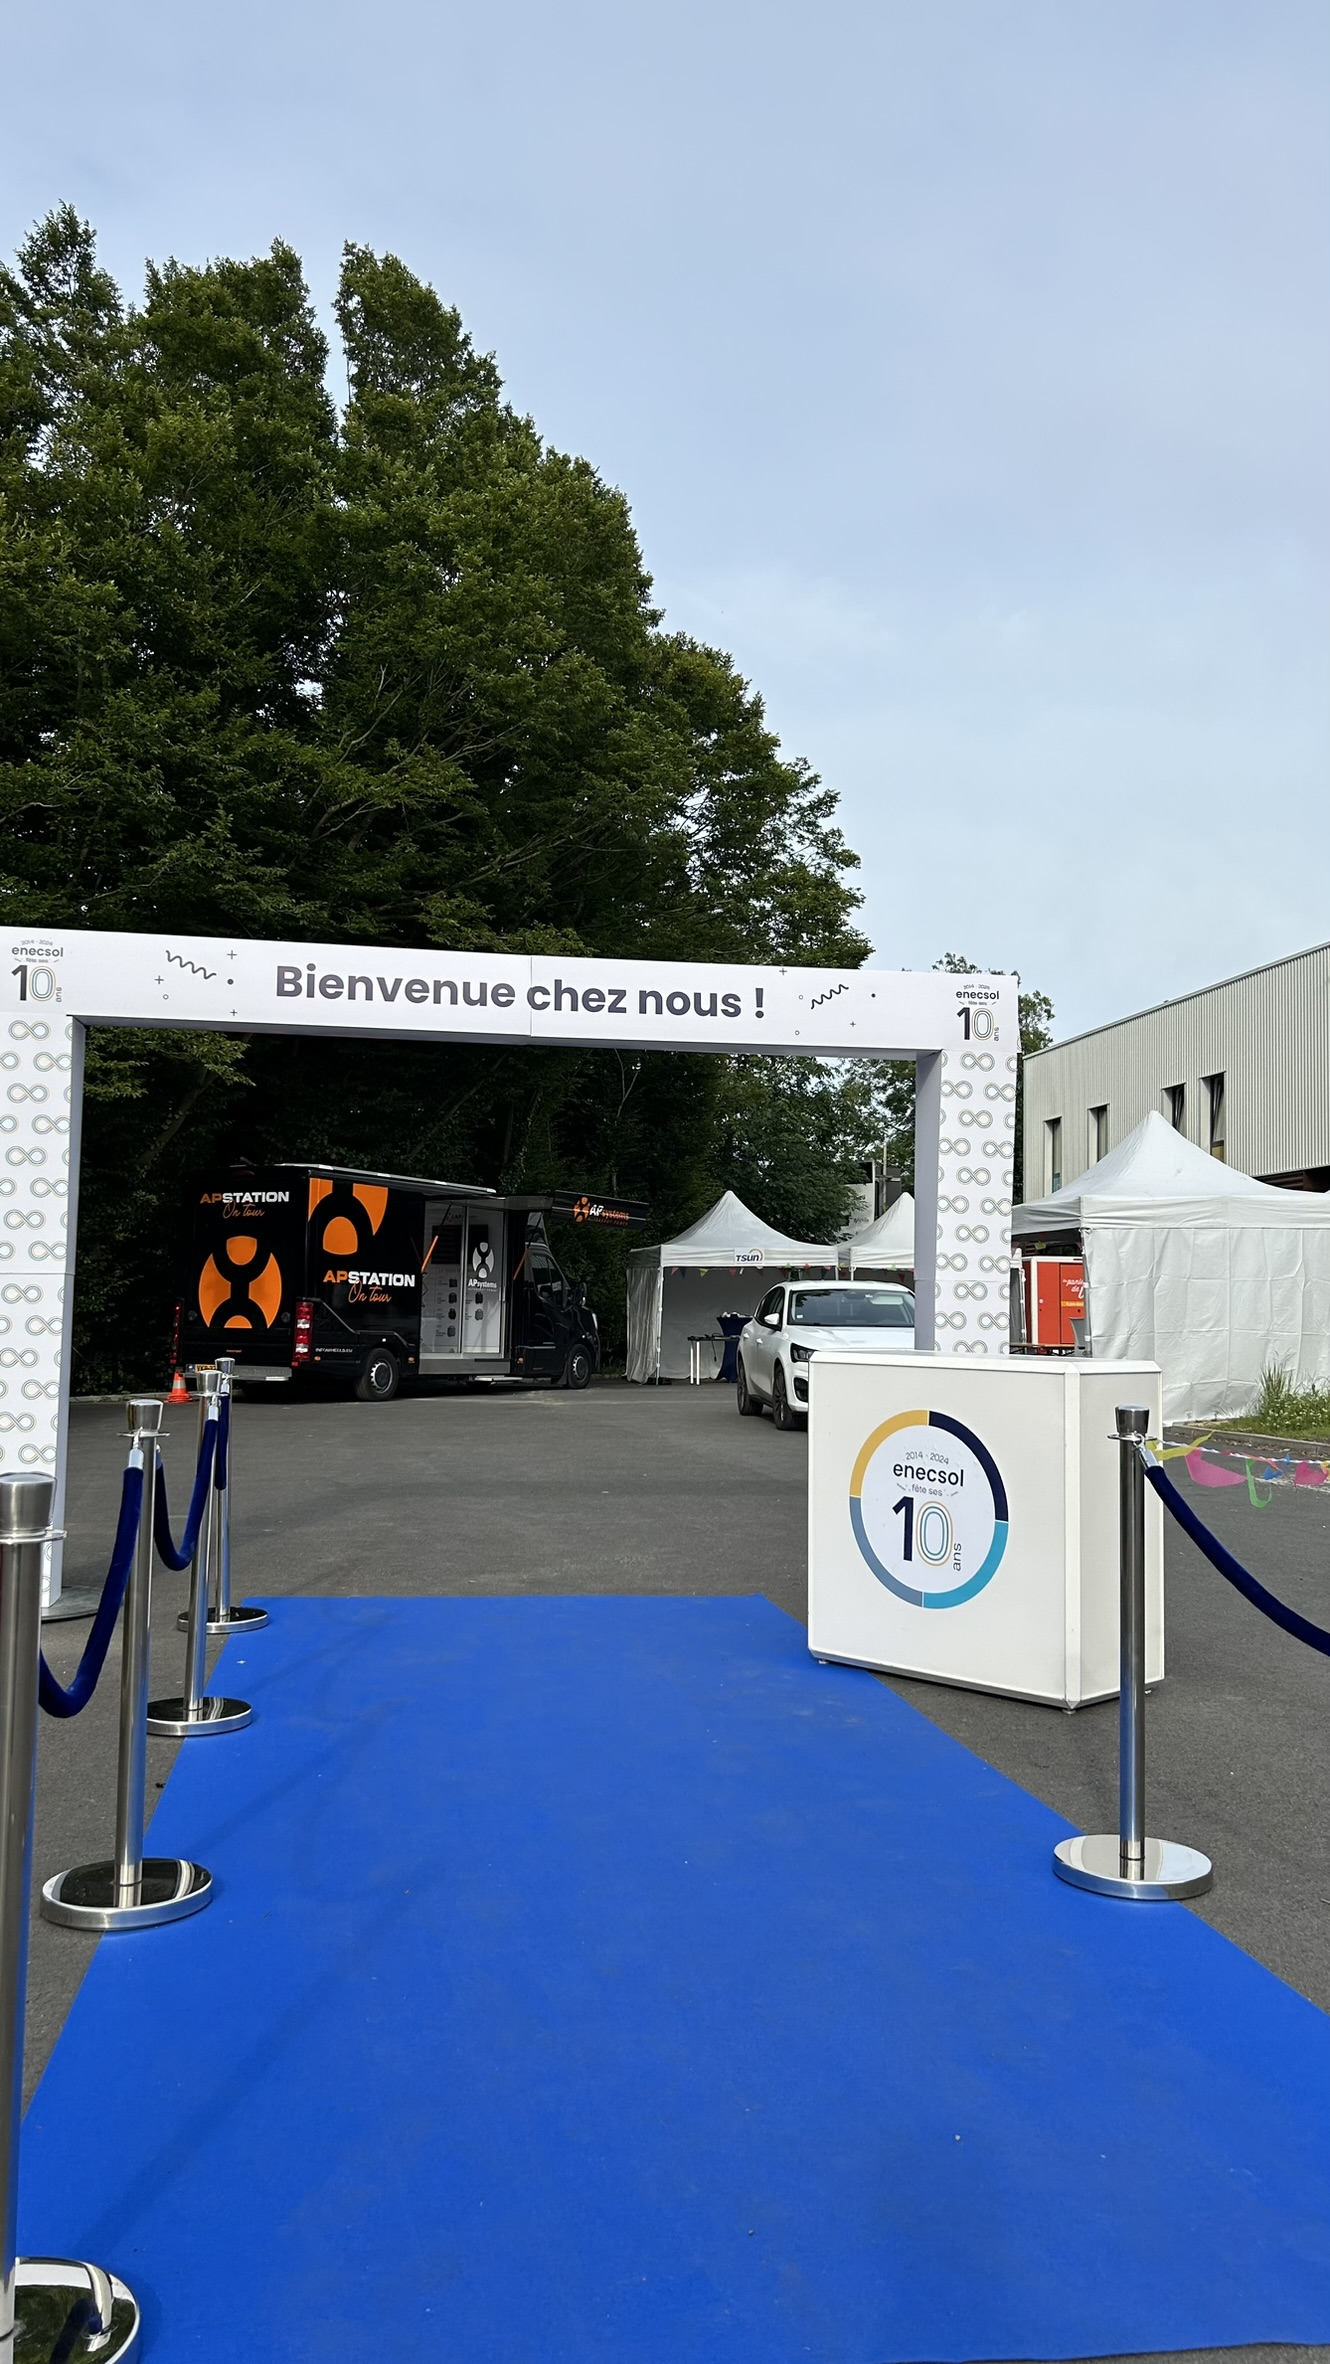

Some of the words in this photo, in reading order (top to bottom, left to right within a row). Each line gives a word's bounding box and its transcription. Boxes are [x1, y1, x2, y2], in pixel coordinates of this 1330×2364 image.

[11, 946, 64, 957] enecsol
[11, 964, 57, 1002] 10
[276, 963, 516, 1008] Bienvenue
[526, 979, 627, 1013] chez
[638, 989, 742, 1018] nous
[956, 990, 999, 1000] enecsol
[956, 1006, 995, 1041] 10
[200, 1191, 290, 1204] APSTATION
[222, 1200, 241, 1219] On
[242, 1203, 265, 1217] tour
[323, 1269, 416, 1287] APSTATION
[348, 1279, 367, 1303] On
[368, 1285, 392, 1302] tour
[905, 1451, 923, 1461] 2014
[929, 1452, 949, 1465] 2024
[892, 1463, 964, 1487] enecsol
[928, 1486, 943, 1497] ses
[892, 1496, 953, 1567] 10
[953, 1543, 962, 1572] ans
